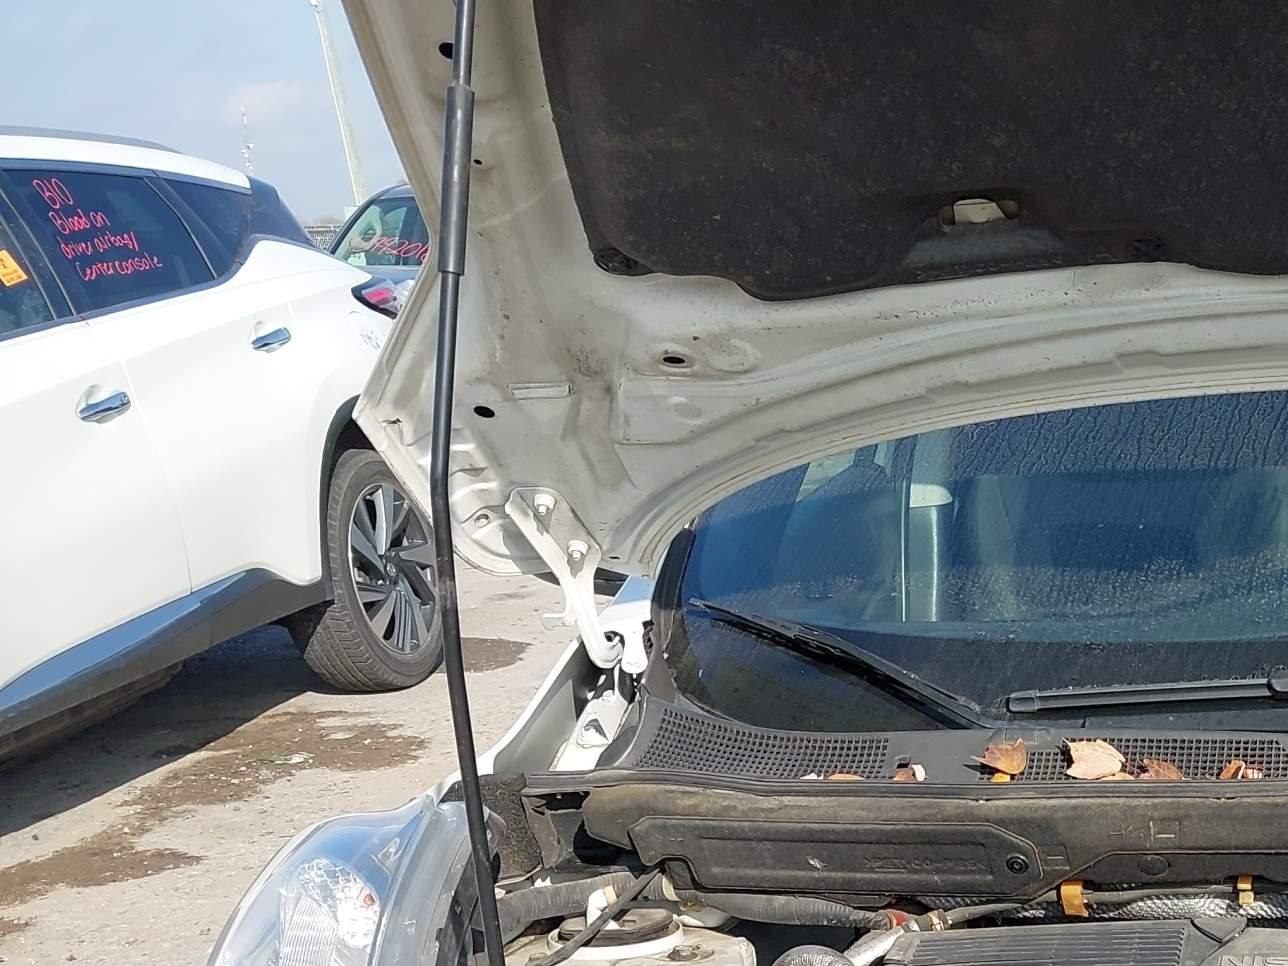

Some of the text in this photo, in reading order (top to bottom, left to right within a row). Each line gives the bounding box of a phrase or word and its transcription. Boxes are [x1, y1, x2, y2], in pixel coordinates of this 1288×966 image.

[32, 177, 74, 209] BIO
[48, 208, 111, 234] Blood on
